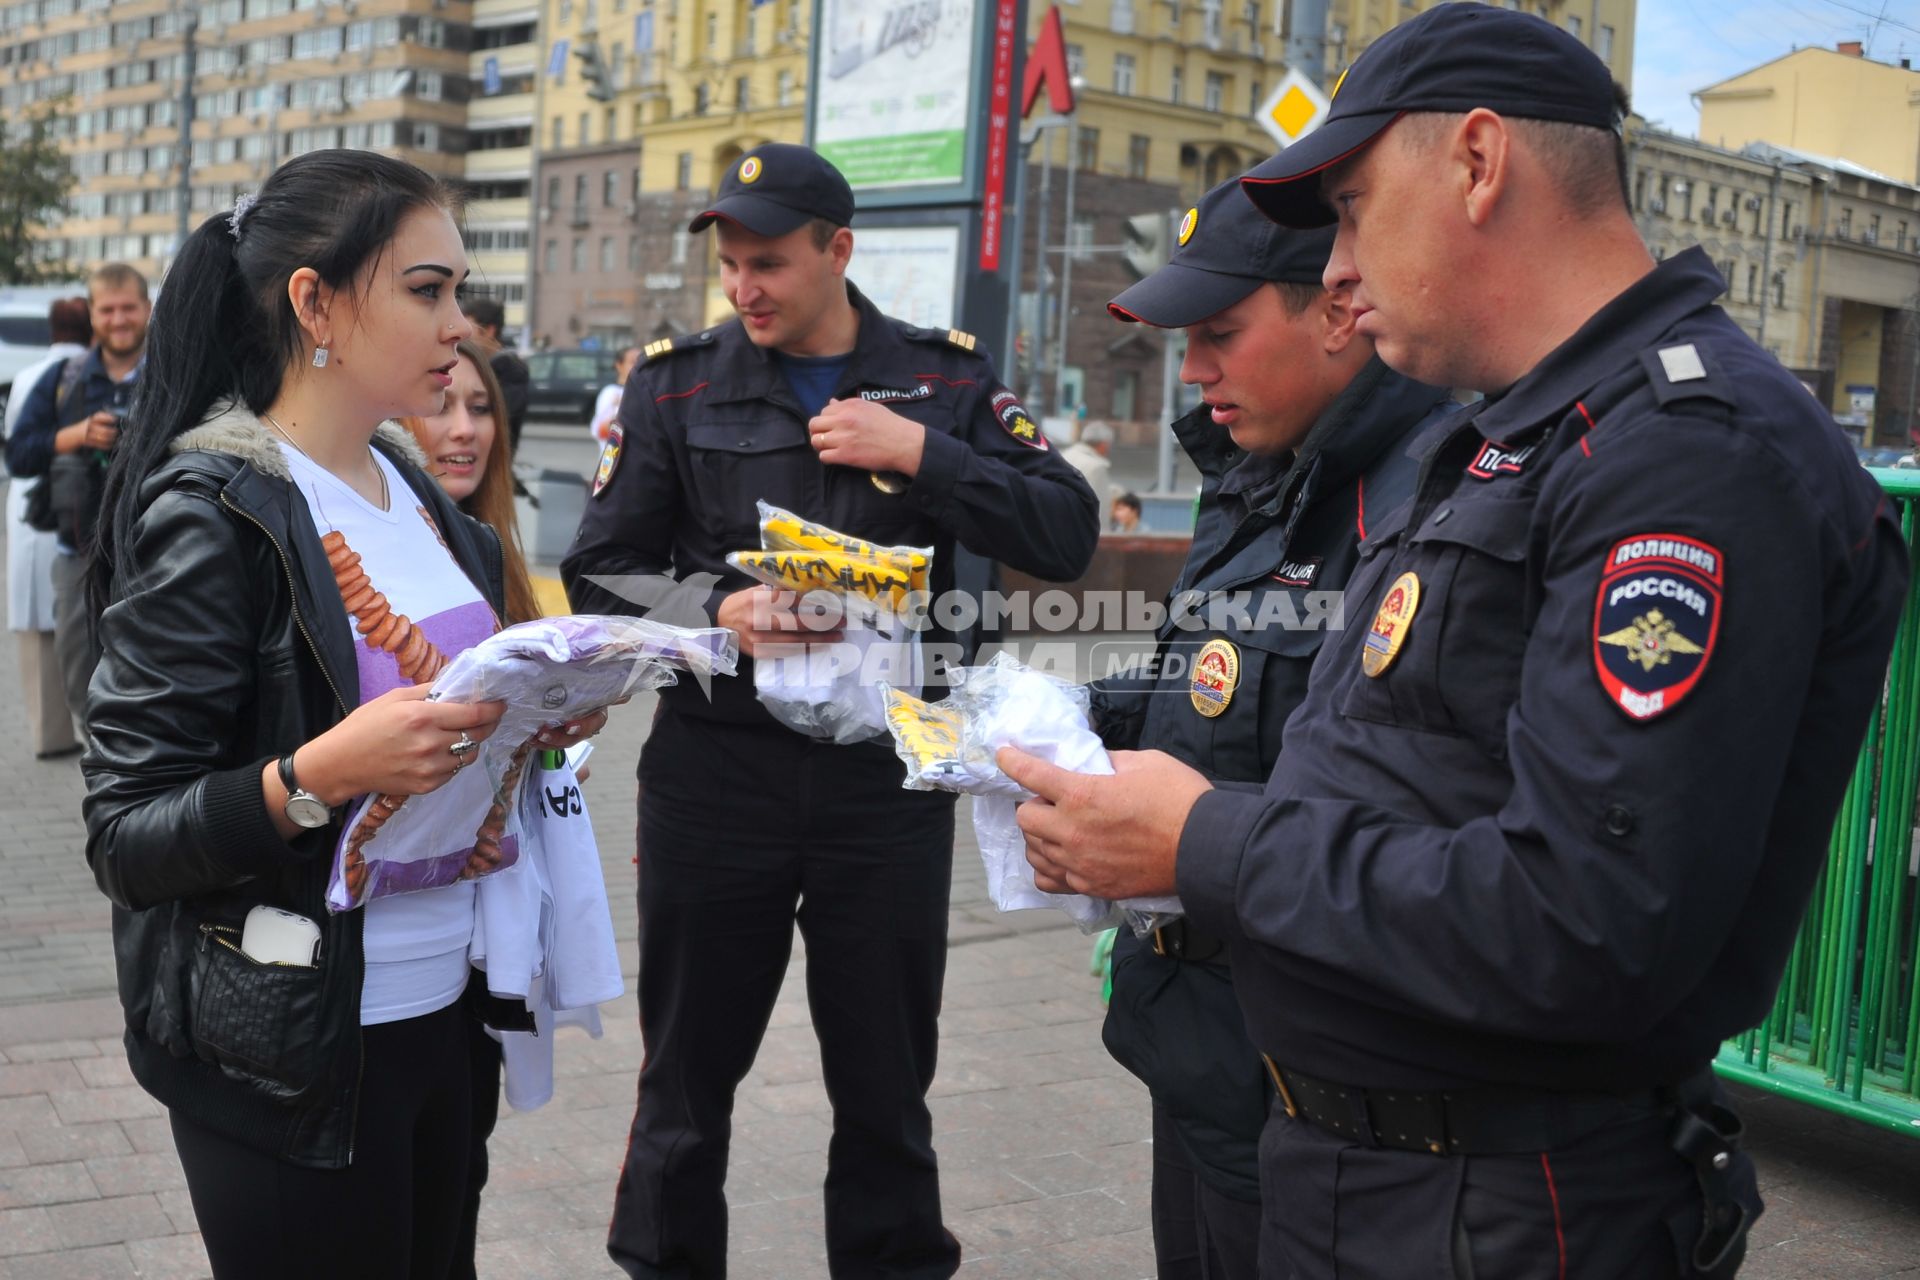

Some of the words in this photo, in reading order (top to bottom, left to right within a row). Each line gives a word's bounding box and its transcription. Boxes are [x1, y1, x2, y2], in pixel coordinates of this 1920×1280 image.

[860, 384, 930, 401] ПОЛИЦИЯ
[1615, 539, 1716, 574] ПОЛИЦИЯ
[1609, 576, 1707, 616] РОССИЯ
